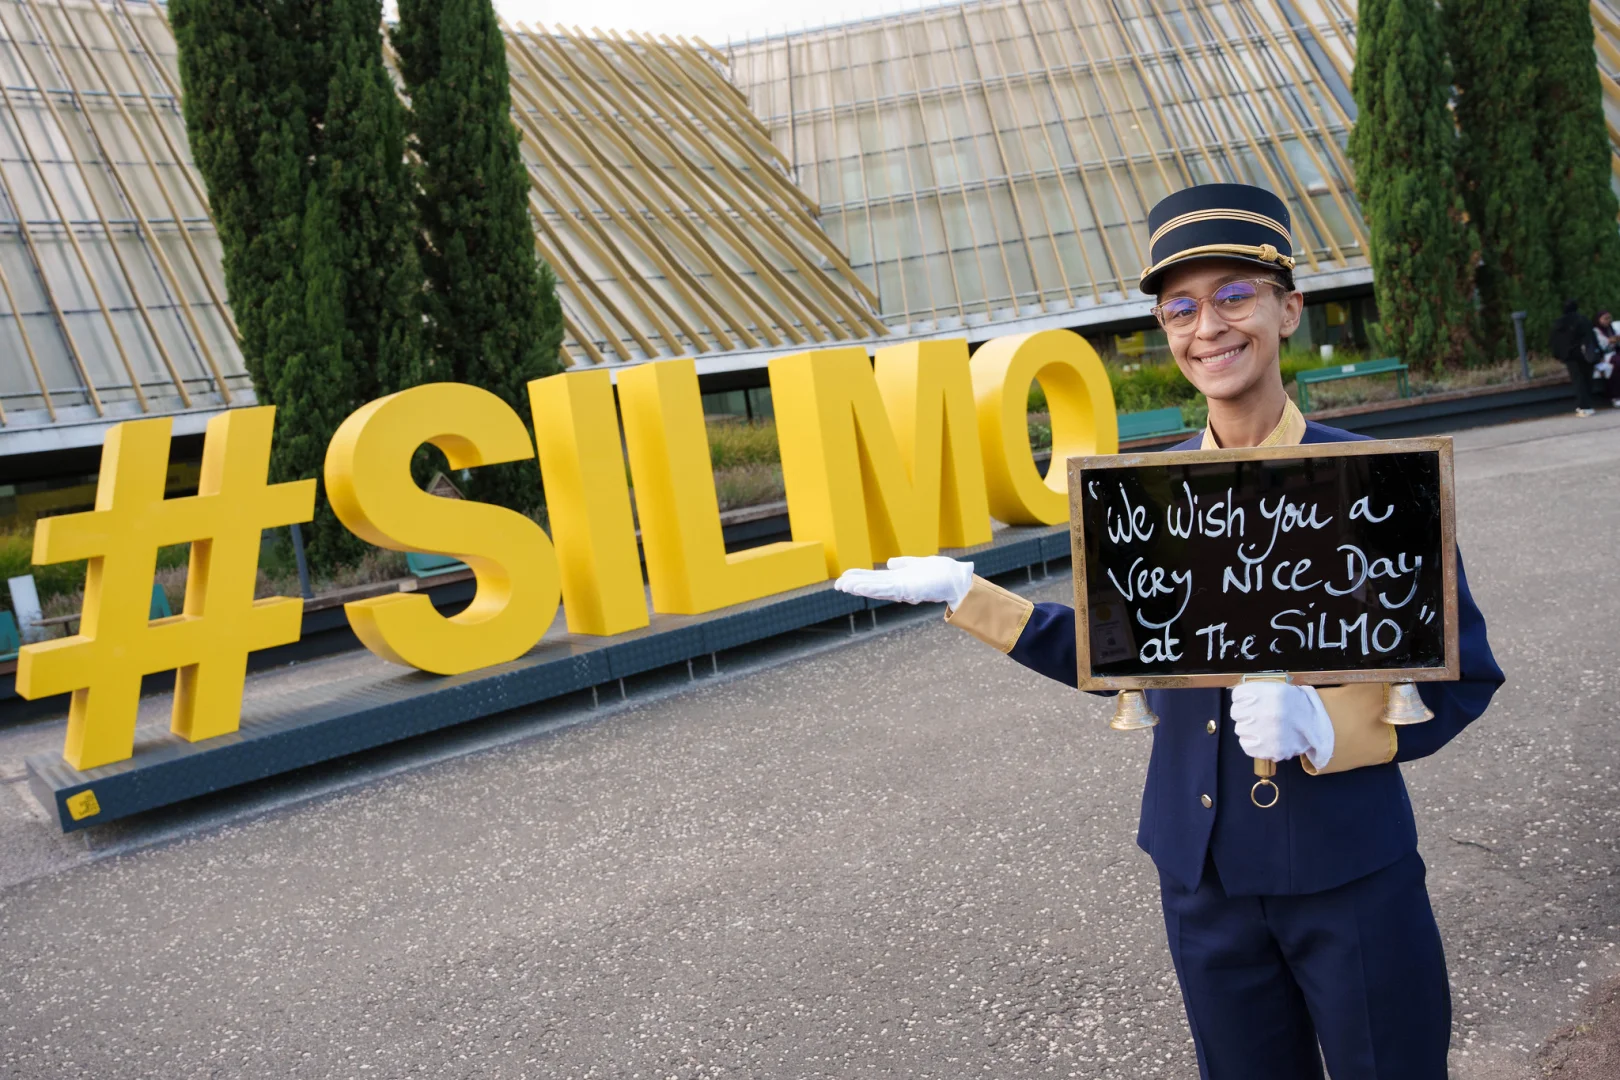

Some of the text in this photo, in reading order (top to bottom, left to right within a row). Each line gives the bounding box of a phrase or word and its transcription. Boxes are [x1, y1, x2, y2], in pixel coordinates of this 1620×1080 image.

[1167, 480, 1245, 539] Wish
[1349, 495, 1394, 523] a
[15, 328, 1119, 770] #SILMO
[1324, 544, 1422, 609] Day
[1139, 622, 1184, 664] at
[1196, 621, 1261, 661] The
